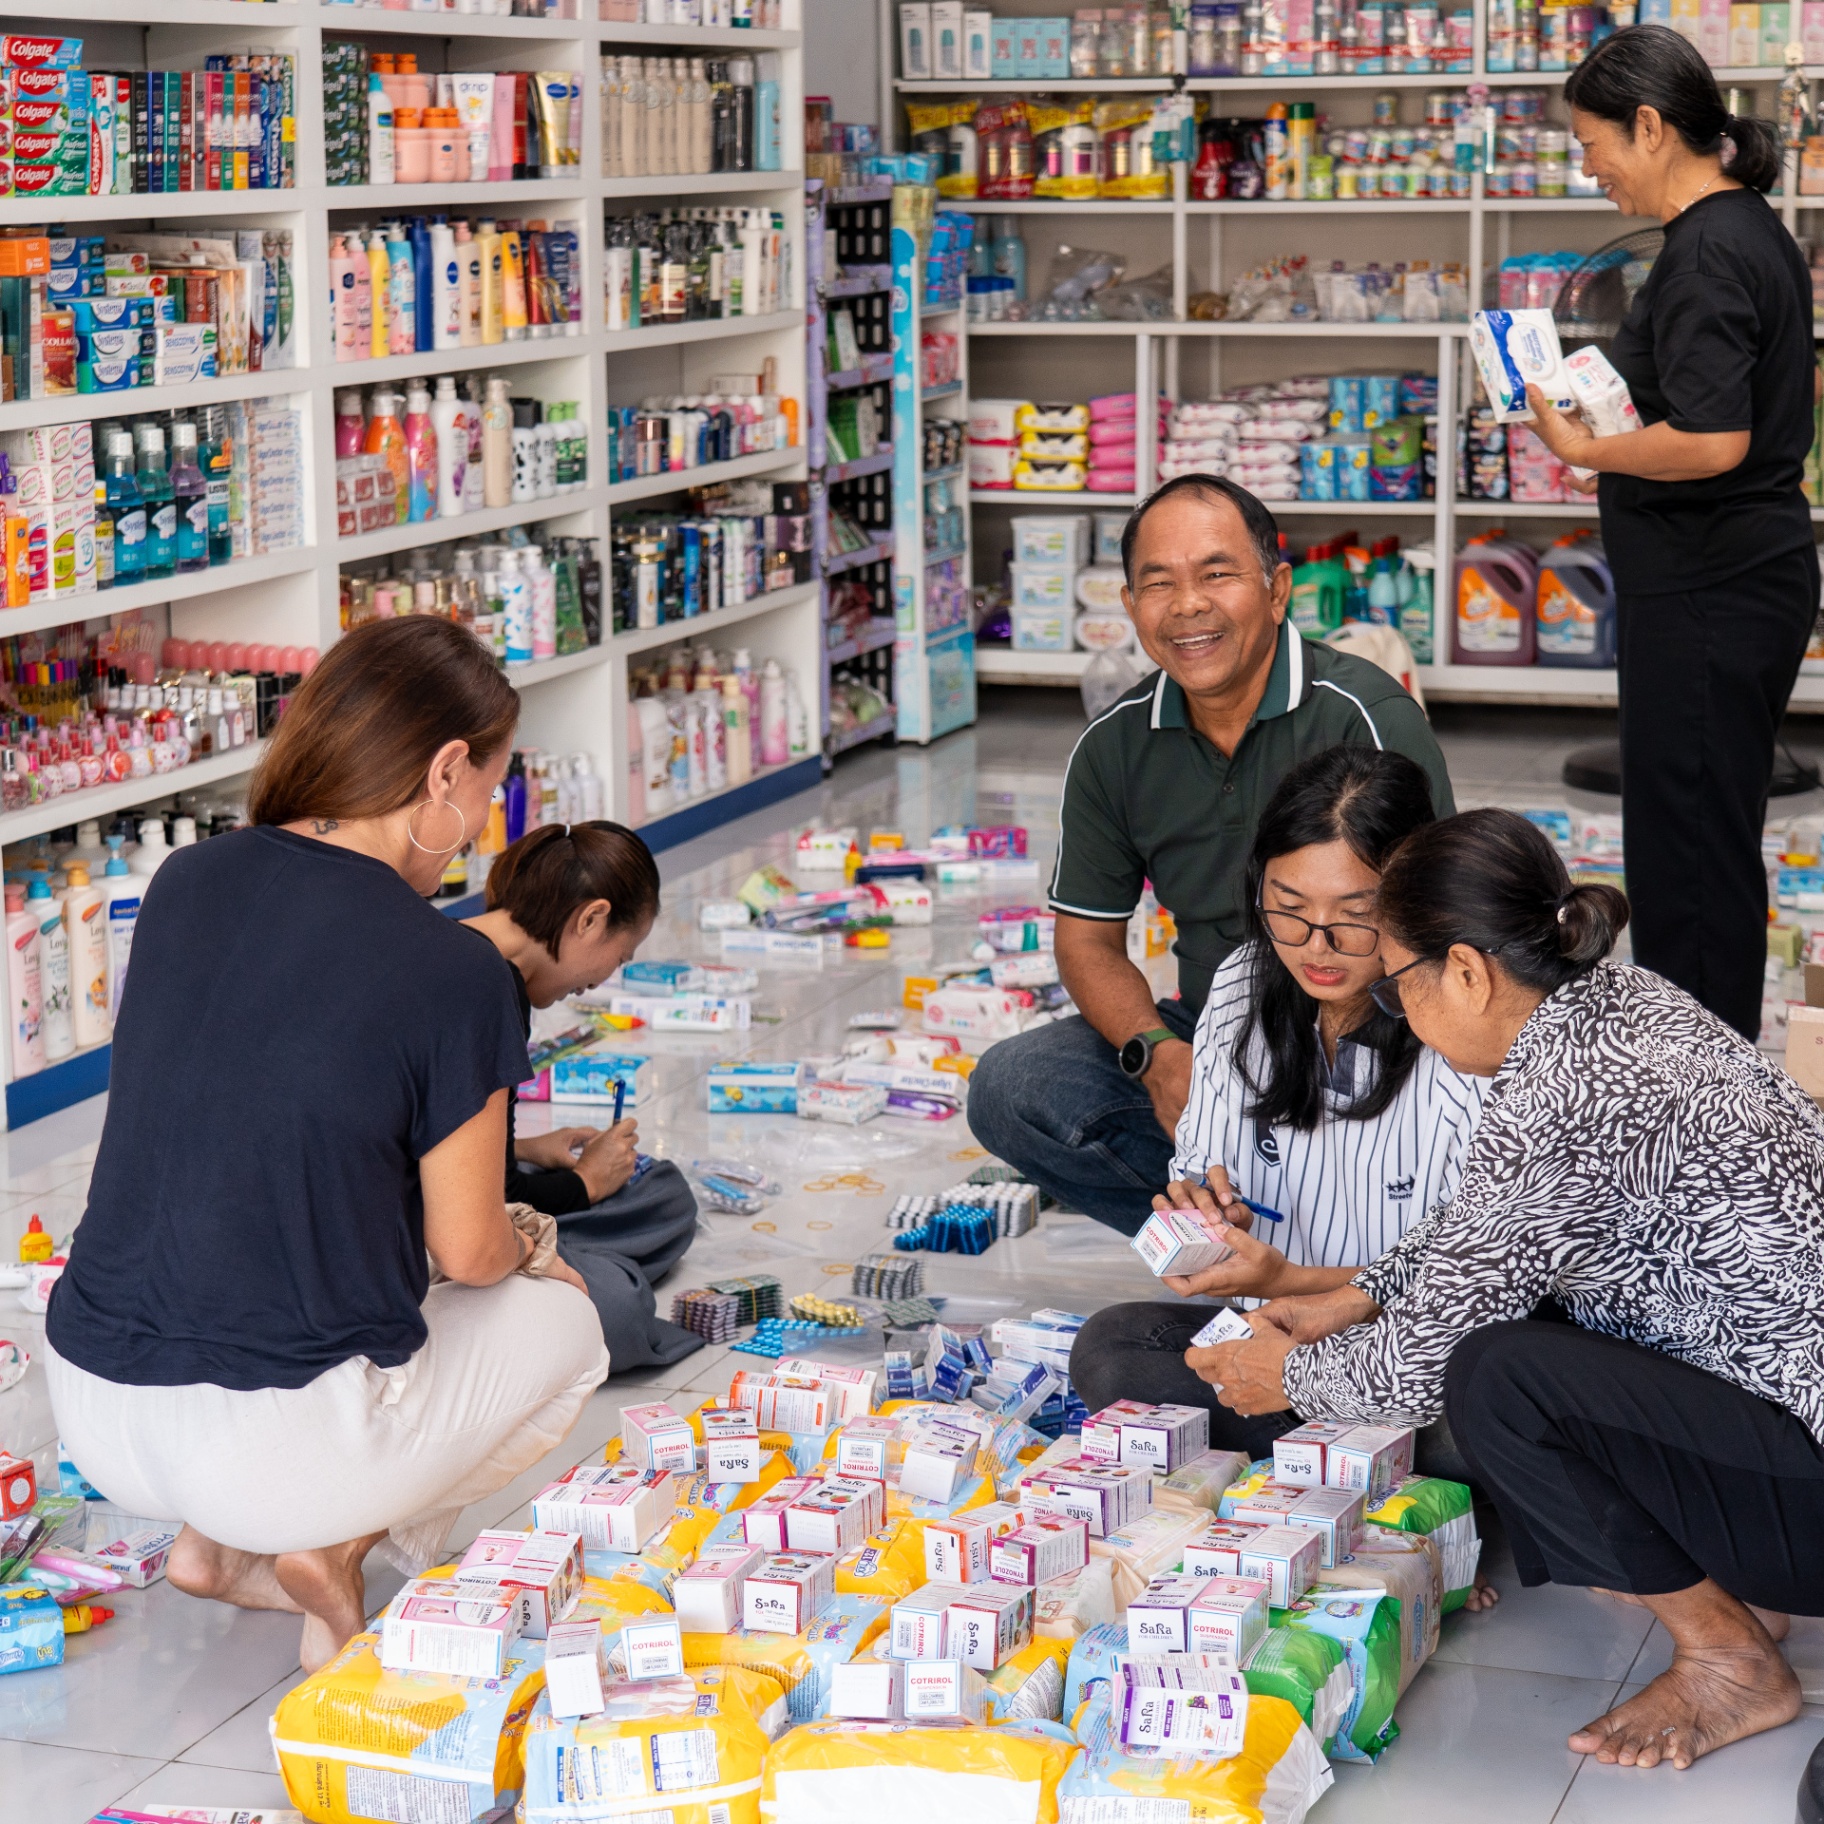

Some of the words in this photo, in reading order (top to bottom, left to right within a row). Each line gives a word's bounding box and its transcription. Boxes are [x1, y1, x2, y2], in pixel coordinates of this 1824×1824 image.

[10, 40, 54, 60] Colgate
[20, 70, 58, 89] Colgate
[15, 104, 54, 121] Colgate
[15, 136, 52, 152] Colgate
[91, 132, 101, 192] Colgate
[15, 168, 51, 184] Colgate
[1146, 1226, 1168, 1254] COTRIROL
[1208, 1323, 1233, 1346] SaRa
[1002, 1394, 1016, 1411] Plus
[654, 1444, 690, 1454] COTRIROL
[1084, 1444, 1114, 1456] SYNOZOLE
[1130, 1440, 1158, 1452] SaRa
[720, 1459, 749, 1470] SaRa
[843, 1464, 879, 1472] COTRIROL
[1284, 1464, 1311, 1474] SaRa
[837, 1478, 867, 1488] SaRa
[1066, 1508, 1093, 1520] SaRa
[935, 1542, 943, 1571] SaRa
[995, 1566, 1024, 1579] SYNOZOLE
[458, 1577, 497, 1585] COTRIROL
[755, 1598, 786, 1611] SaRa
[522, 1600, 531, 1626] SaRa
[1140, 1623, 1172, 1635] SaRa
[1193, 1624, 1234, 1636] COTRIROL
[632, 1640, 674, 1650] COTRIROL
[968, 1622, 978, 1655] SaRa
[910, 1677, 953, 1685] COTRIROL
[1139, 1701, 1154, 1733] SaRa
